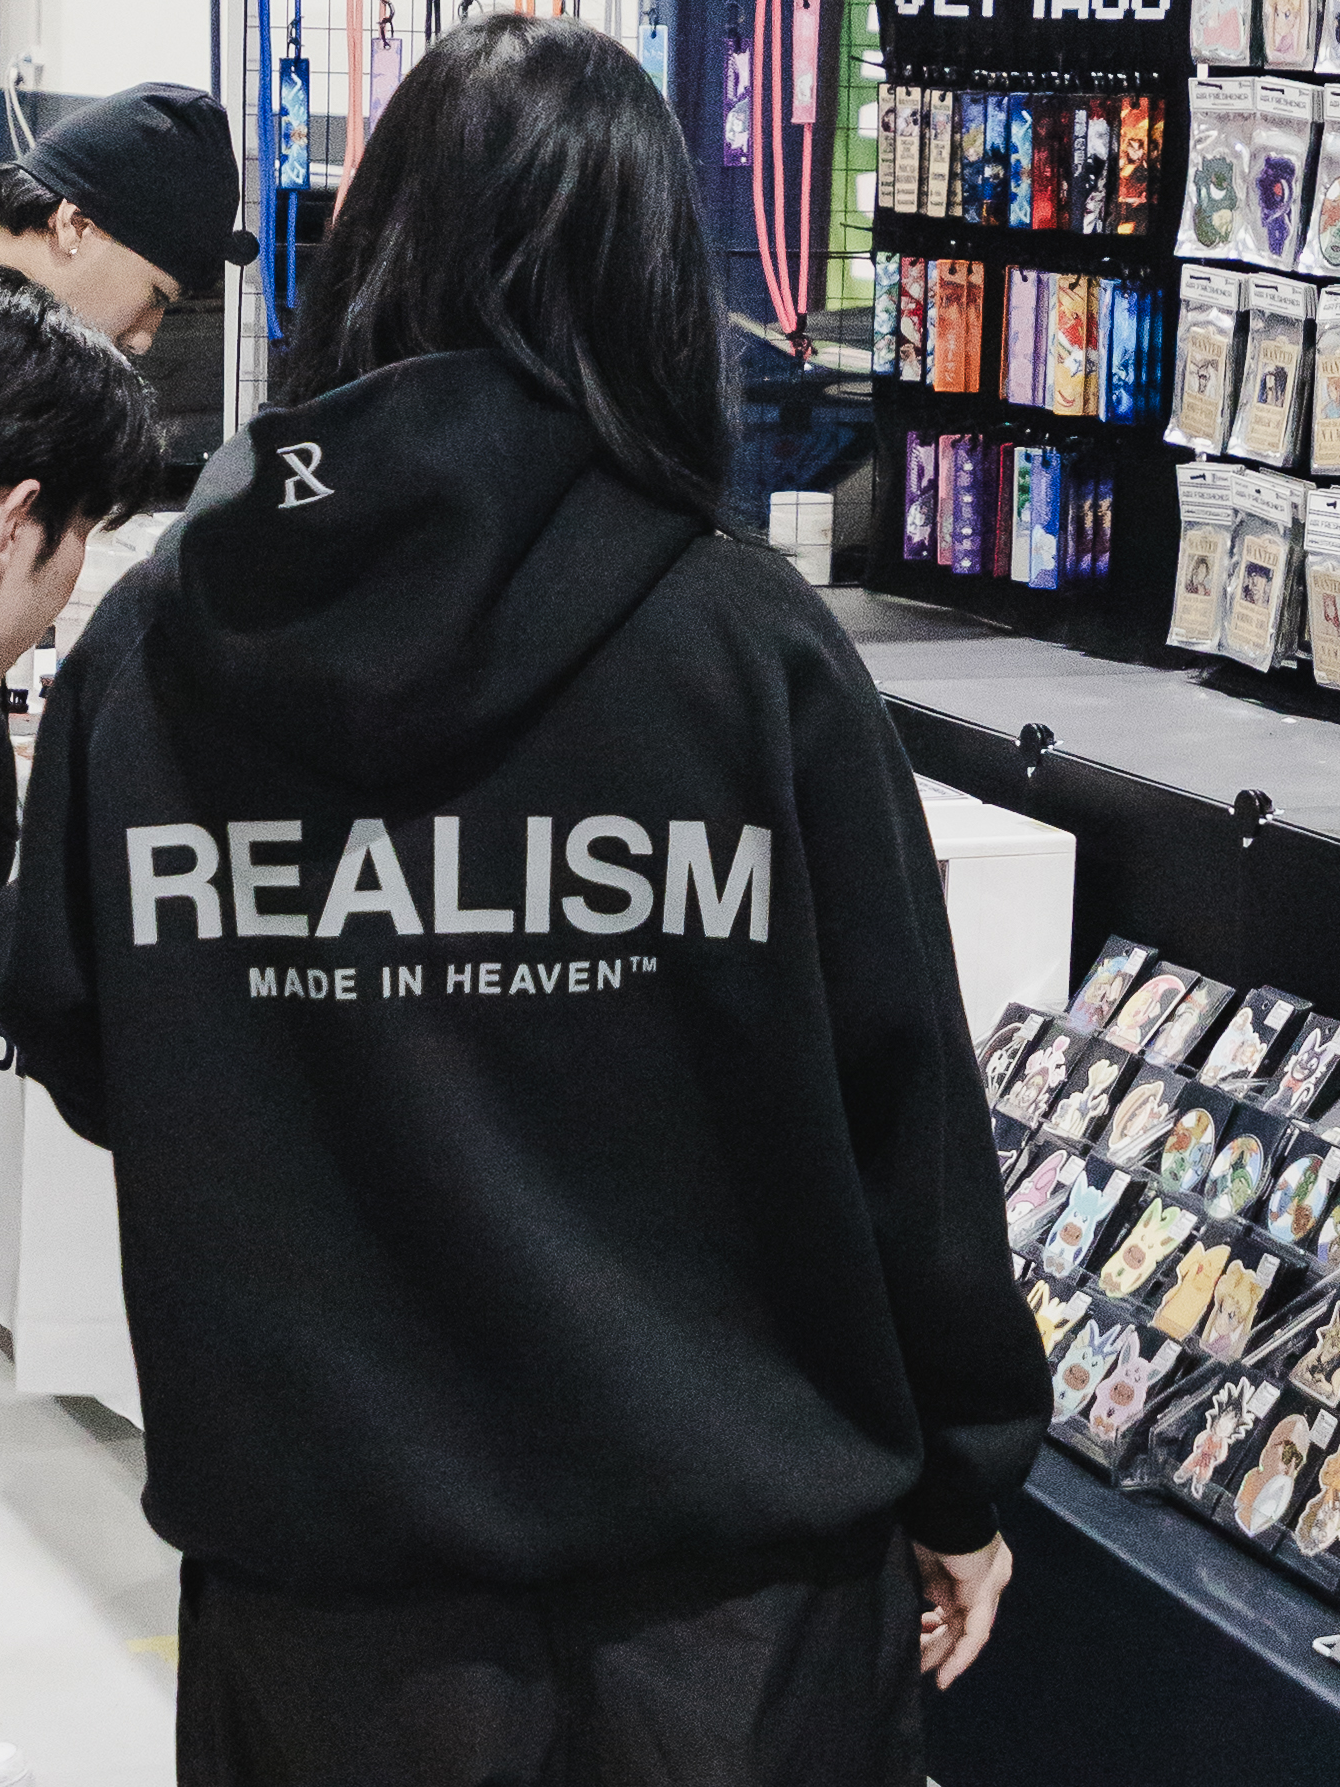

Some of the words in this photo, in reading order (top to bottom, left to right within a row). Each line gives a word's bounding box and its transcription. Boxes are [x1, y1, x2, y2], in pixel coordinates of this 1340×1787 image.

[125, 814, 773, 947] REALISM
[248, 966, 358, 1002] MADE
[382, 964, 423, 1000] IN
